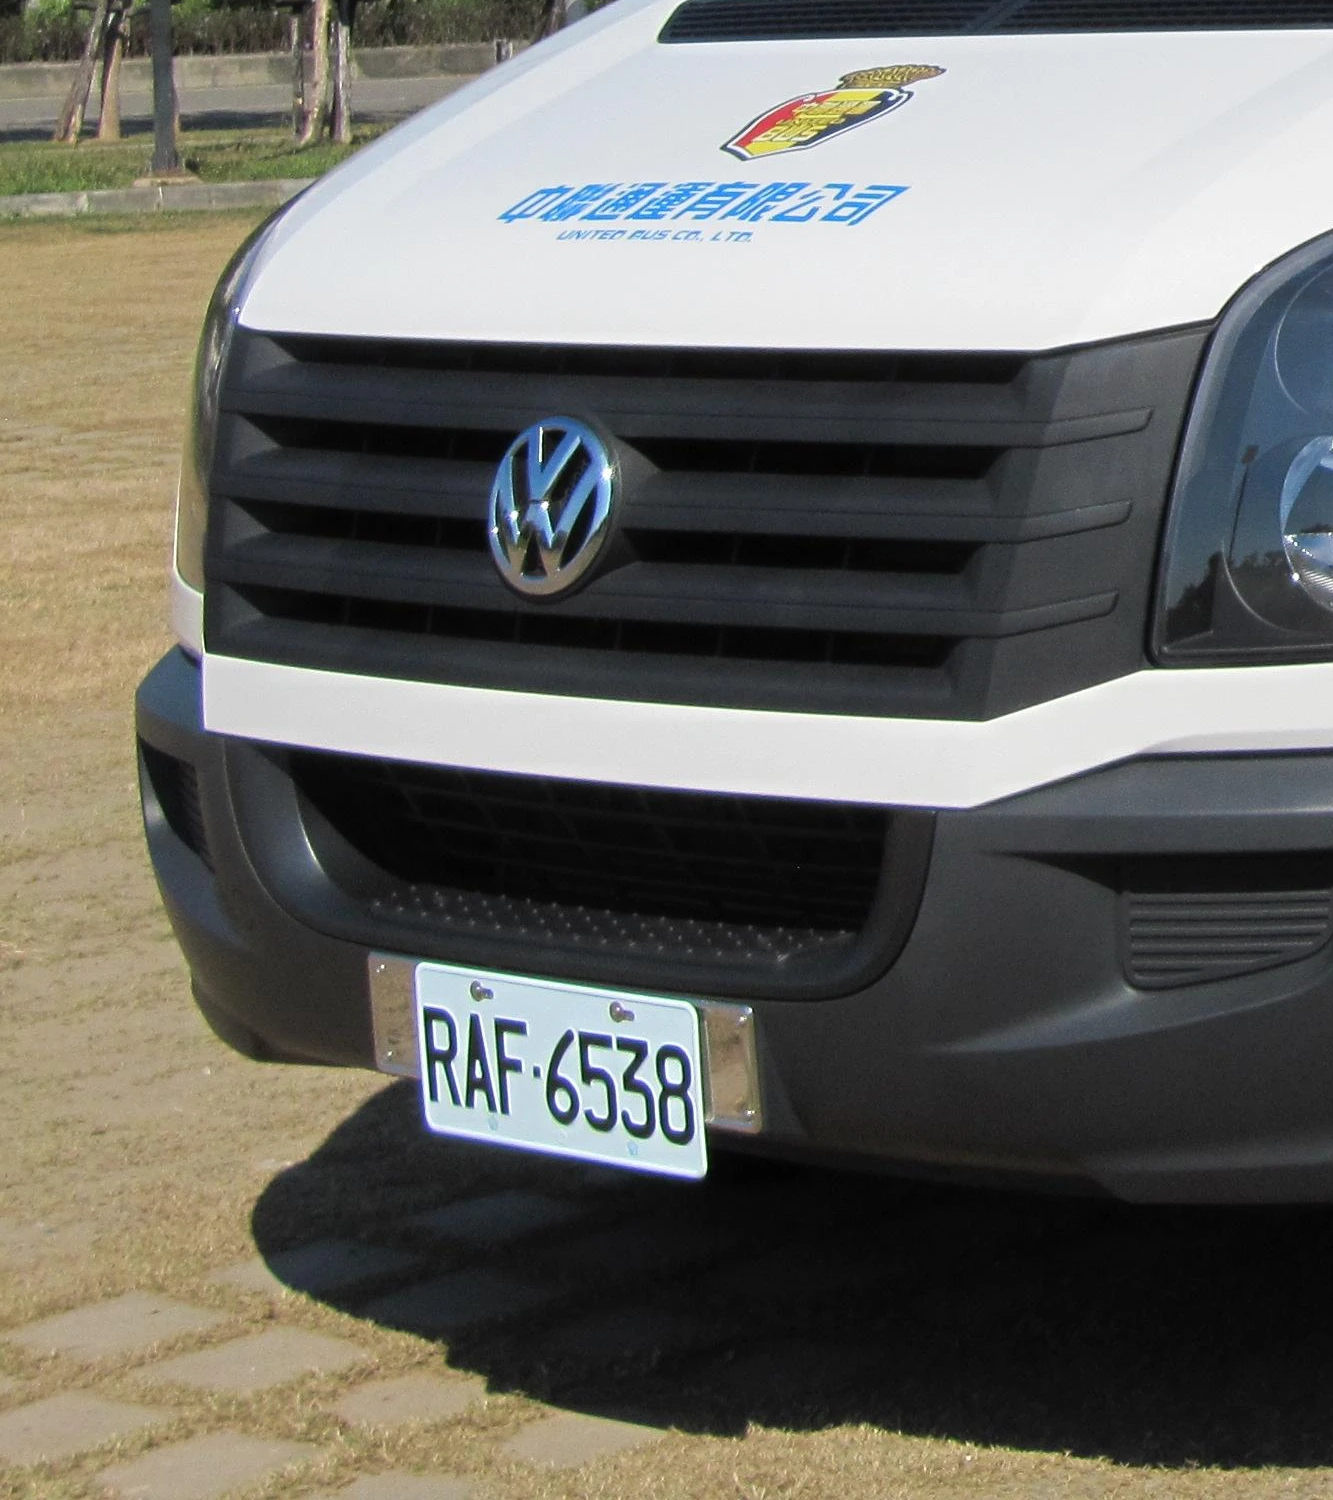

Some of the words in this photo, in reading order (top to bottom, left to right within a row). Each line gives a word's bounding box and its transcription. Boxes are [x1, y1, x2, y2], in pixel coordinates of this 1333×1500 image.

[496, 180, 912, 226] 中聯通運有限公司
[555, 229, 628, 241] UNITED
